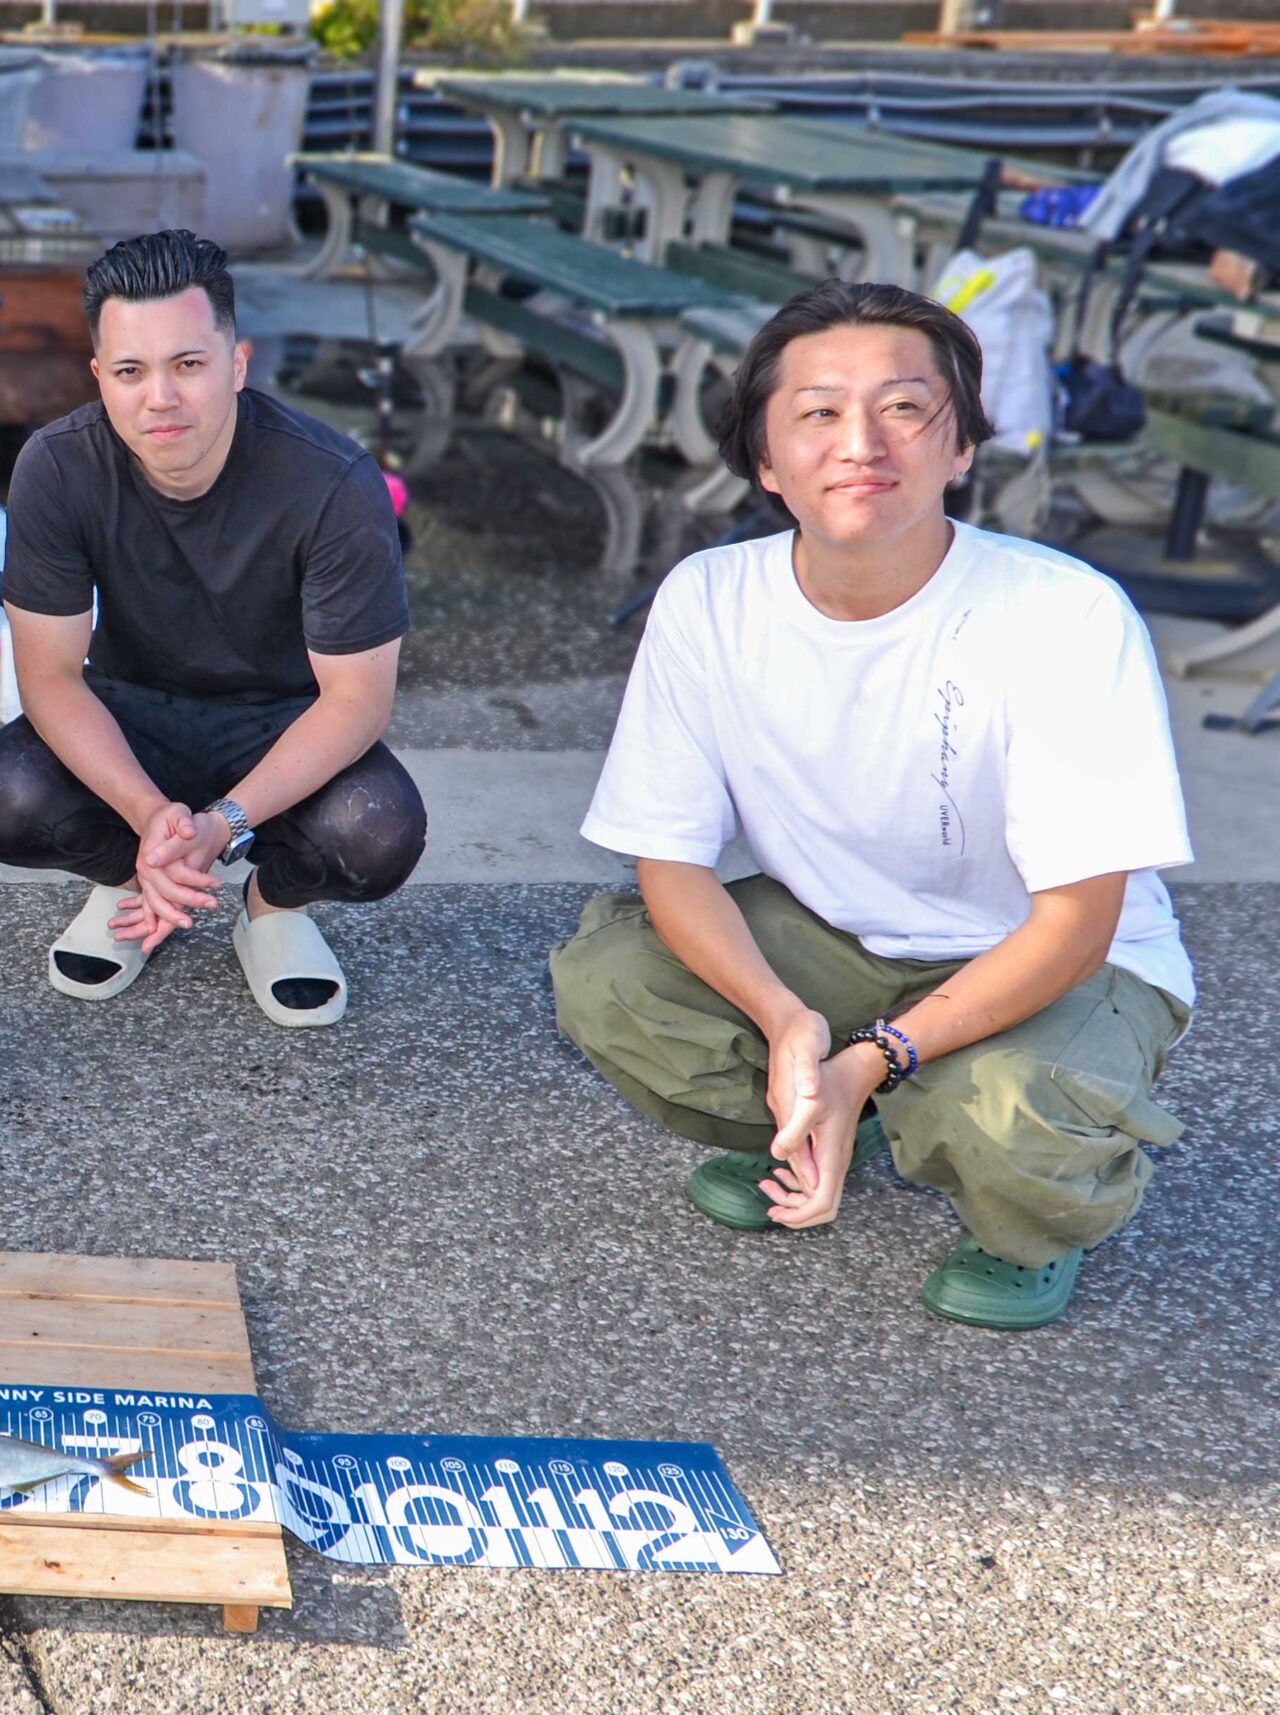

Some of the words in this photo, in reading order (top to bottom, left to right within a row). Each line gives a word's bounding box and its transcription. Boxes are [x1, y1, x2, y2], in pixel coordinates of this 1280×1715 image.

[939, 804, 952, 846] UVERworld
[53, 1391, 106, 1405] SIDE
[114, 1394, 214, 1410] MARINA
[34, 1410, 48, 1419] 65
[89, 1412, 102, 1421] 70
[141, 1414, 155, 1424] 75
[196, 1418, 210, 1426] 80
[250, 1418, 264, 1429] 85
[337, 1457, 351, 1466] 95
[390, 1458, 408, 1469] 100
[444, 1460, 462, 1470] 105
[499, 1461, 516, 1471] 110
[552, 1463, 570, 1473] 115
[607, 1464, 624, 1474] 120
[661, 1466, 678, 1476] 125
[173, 1440, 261, 1520] 8
[275, 1462, 352, 1554] 9
[720, 1527, 749, 1542] 130
